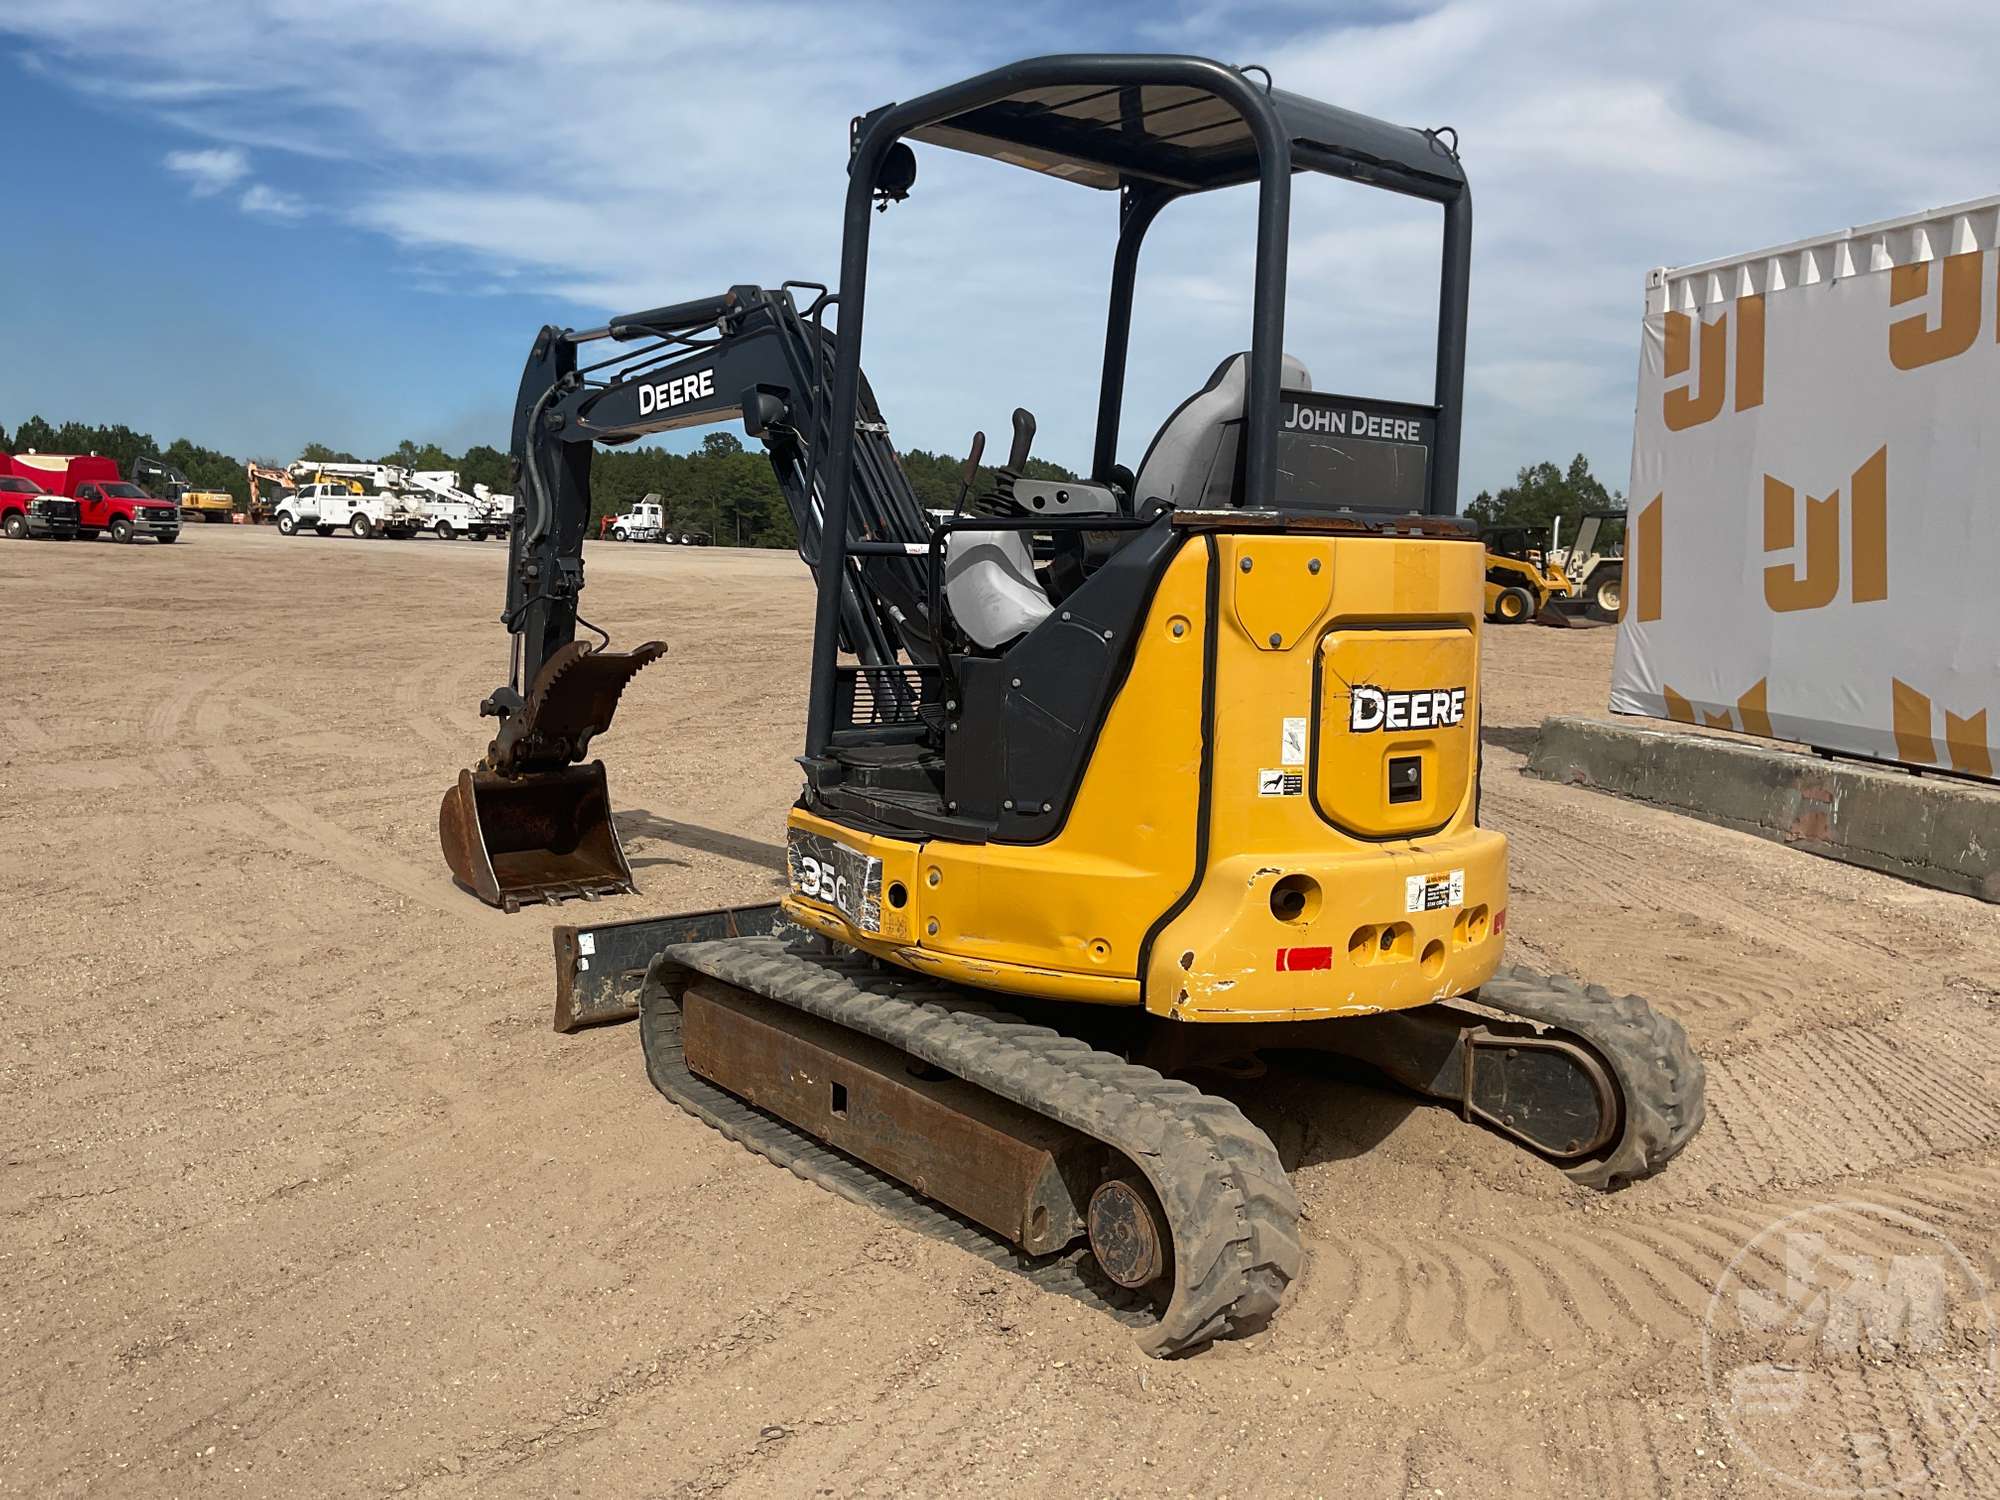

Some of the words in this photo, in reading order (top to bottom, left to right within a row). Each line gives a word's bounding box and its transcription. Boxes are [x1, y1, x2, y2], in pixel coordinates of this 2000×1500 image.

[638, 368, 715, 417] DEERE
[1285, 403, 1346, 434] JOHN
[1351, 410, 1421, 441] DEERE
[1350, 686, 1467, 731] DEERE
